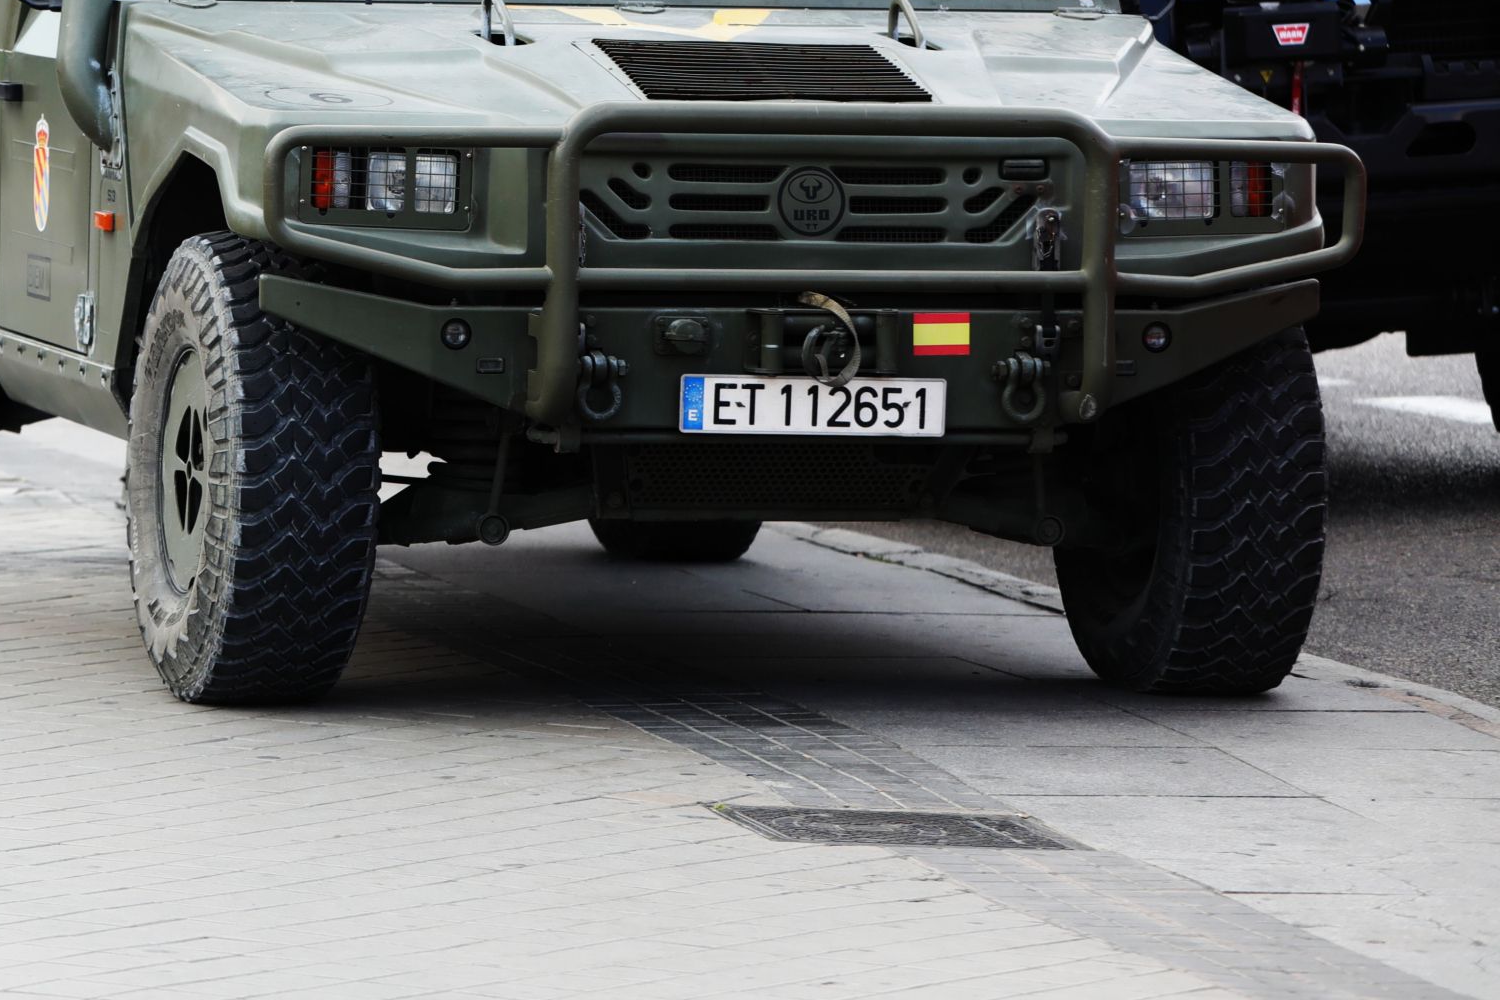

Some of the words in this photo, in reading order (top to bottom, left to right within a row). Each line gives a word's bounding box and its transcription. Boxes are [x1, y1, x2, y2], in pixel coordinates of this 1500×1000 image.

[794, 209, 830, 221] URO
[688, 409, 699, 422] E
[713, 382, 766, 426] ET
[780, 384, 927, 429] 112651
